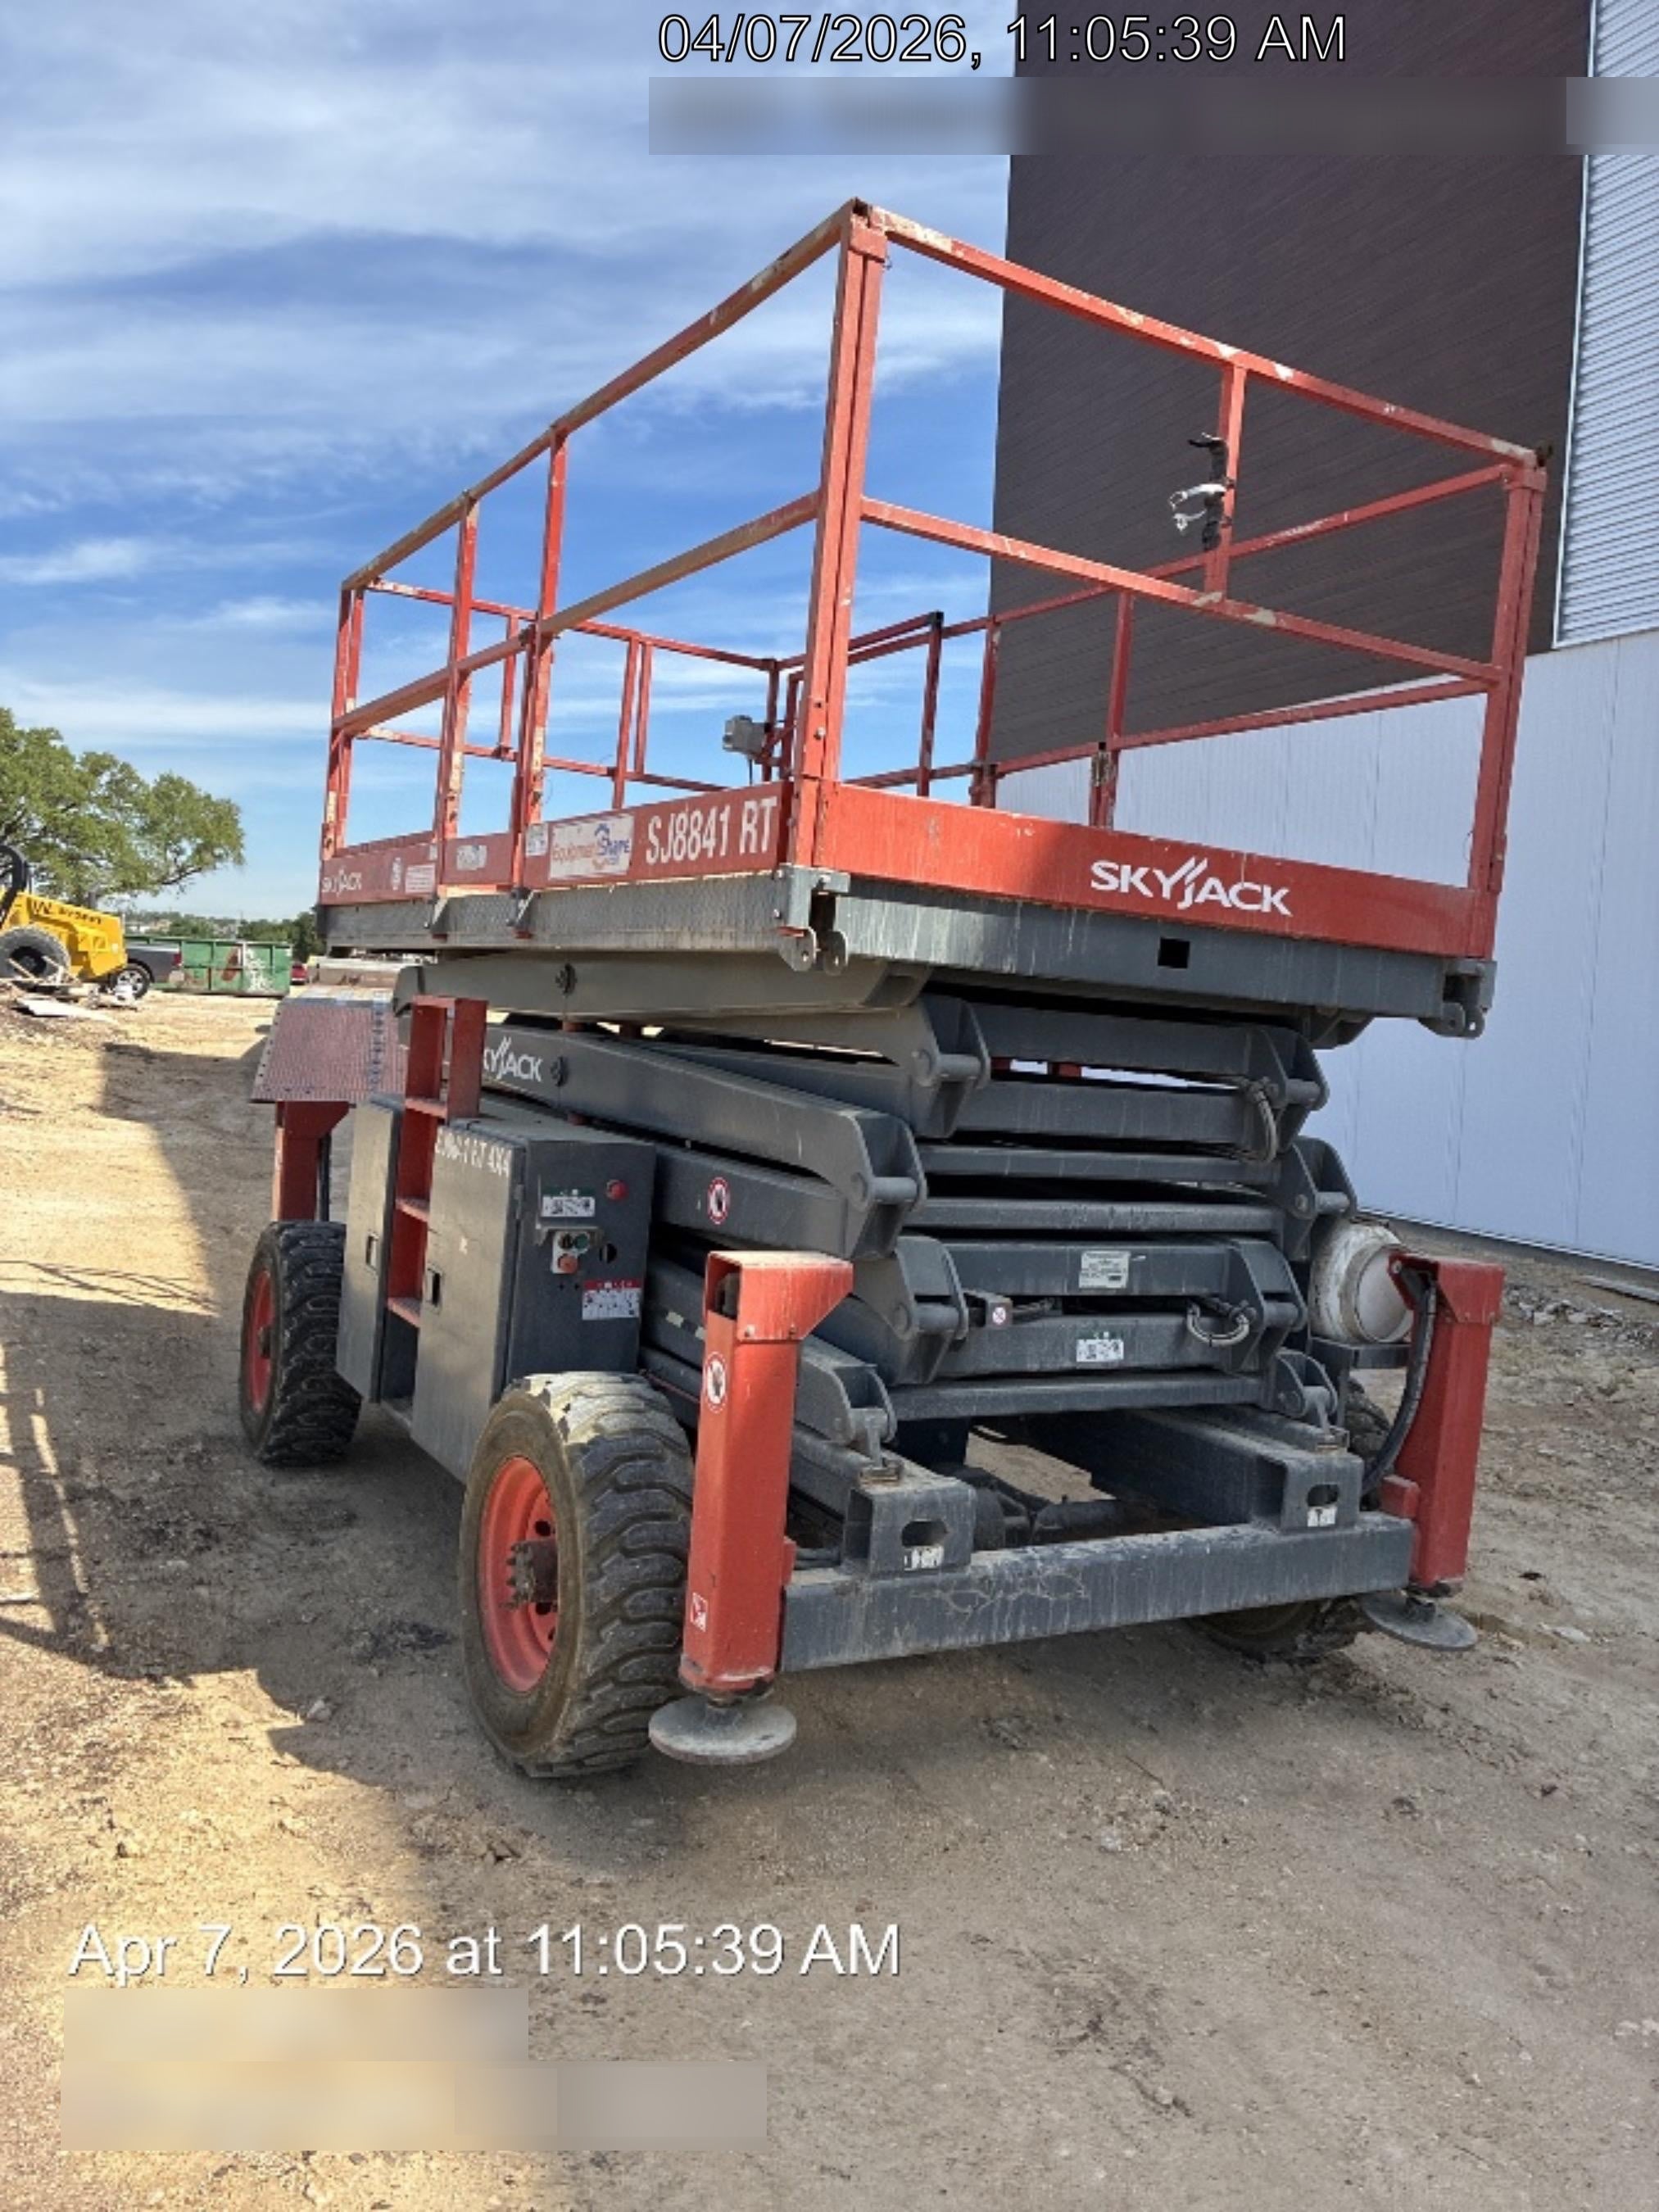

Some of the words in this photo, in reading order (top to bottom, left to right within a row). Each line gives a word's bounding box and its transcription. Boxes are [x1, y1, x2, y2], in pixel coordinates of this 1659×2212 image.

[646, 805, 731, 865] SJ8841
[739, 796, 777, 855] RT
[1090, 856, 1293, 917] SKYJACK
